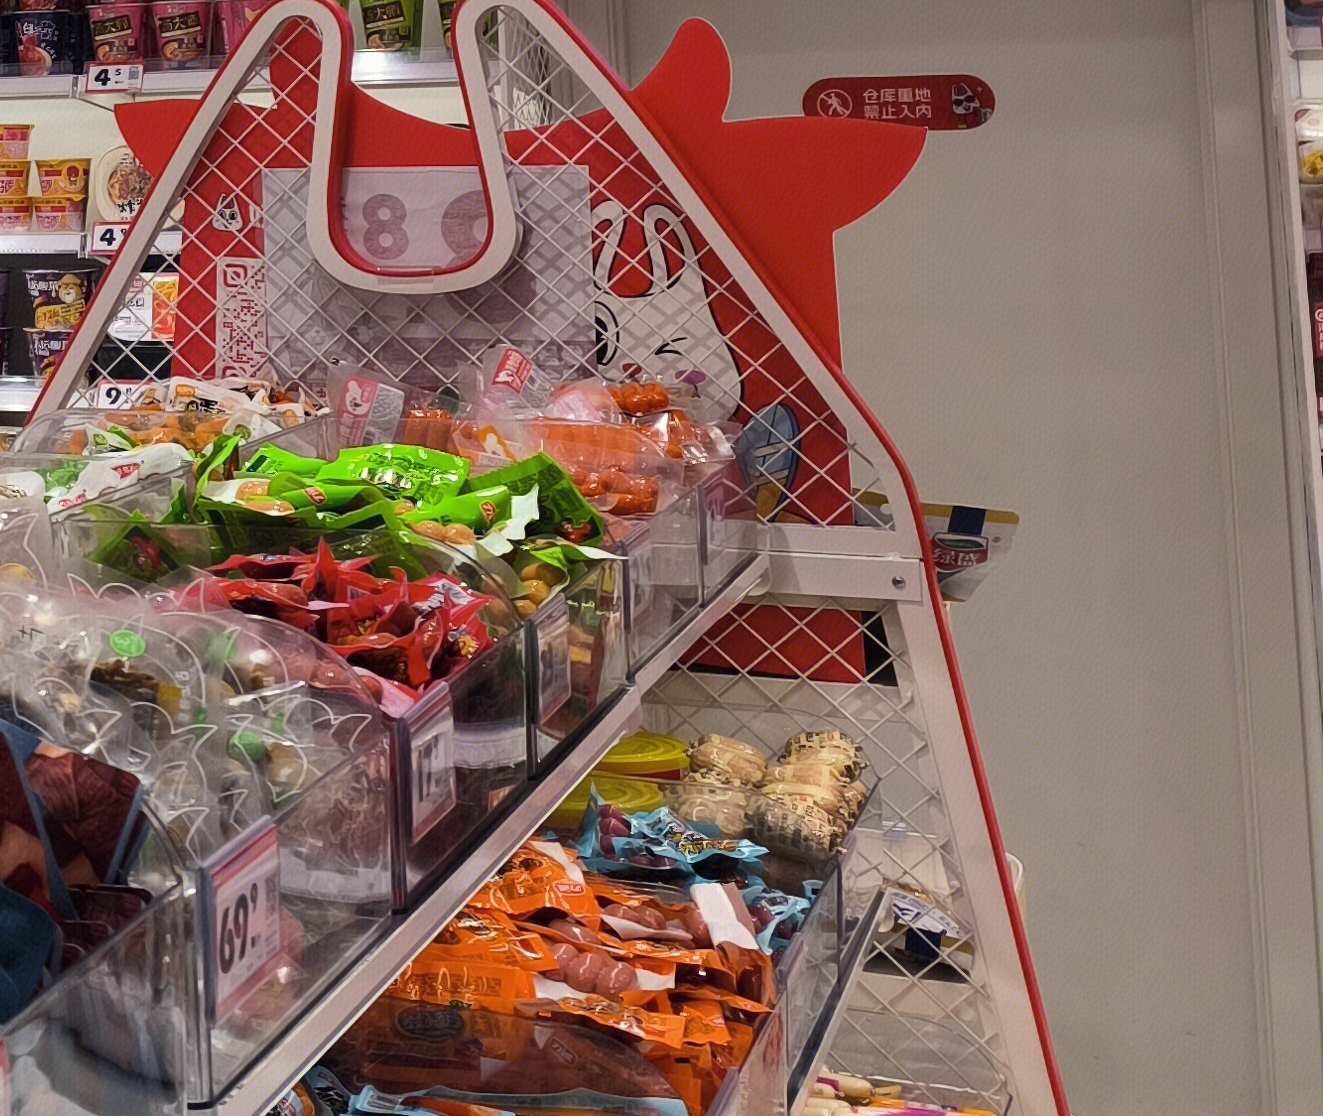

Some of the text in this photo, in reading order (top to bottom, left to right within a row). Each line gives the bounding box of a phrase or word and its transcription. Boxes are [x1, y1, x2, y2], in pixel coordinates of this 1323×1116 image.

[862, 87, 932, 103] 仓库重地
[864, 104, 932, 120] 禁止入内
